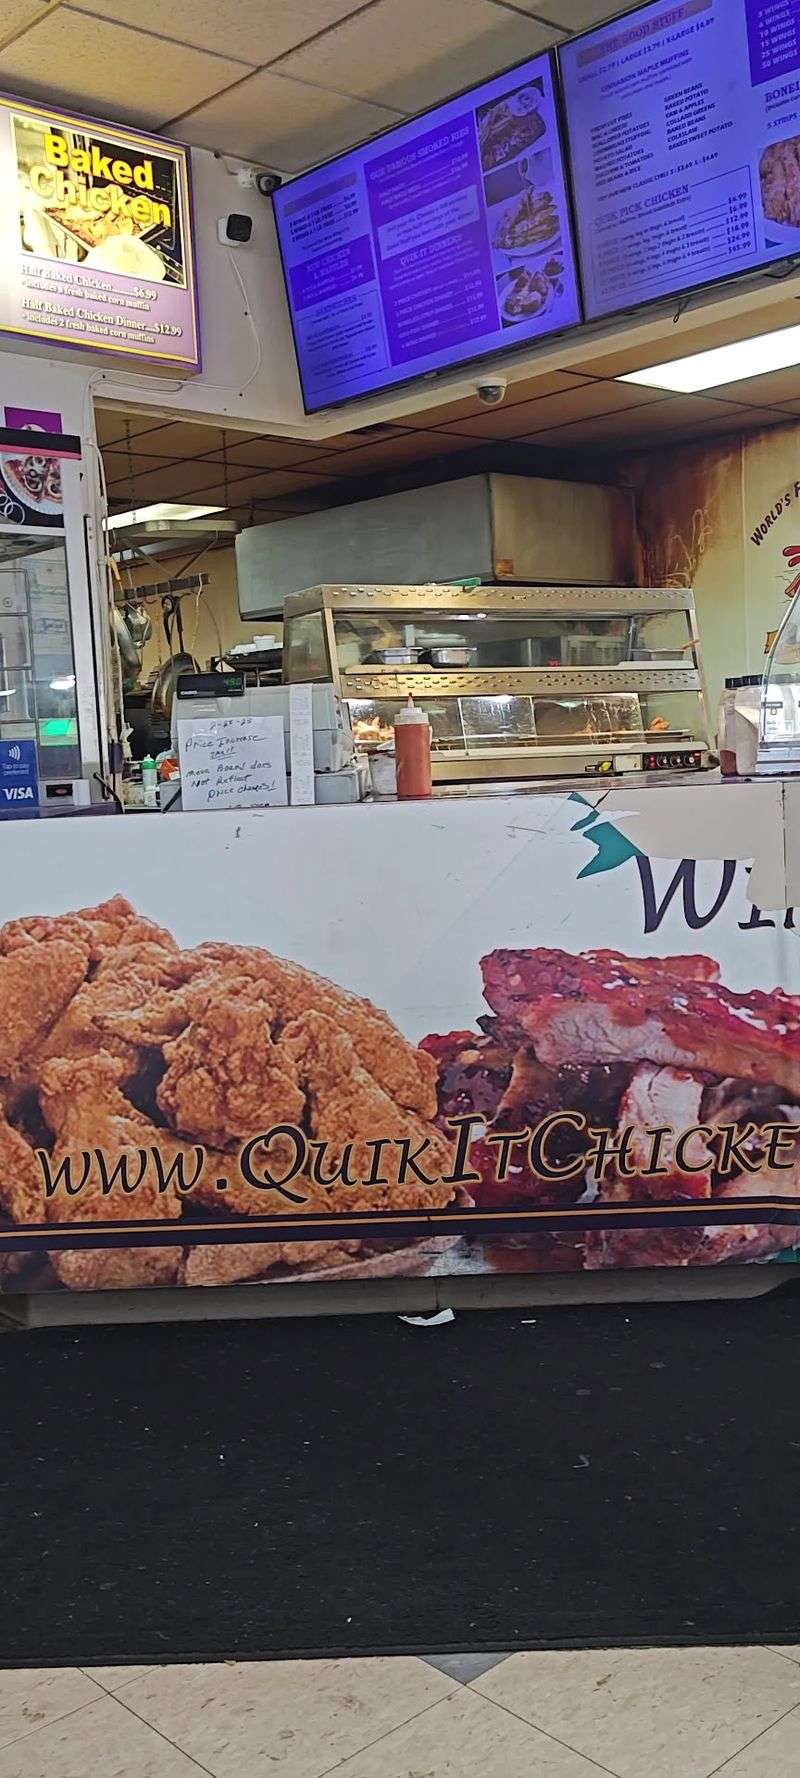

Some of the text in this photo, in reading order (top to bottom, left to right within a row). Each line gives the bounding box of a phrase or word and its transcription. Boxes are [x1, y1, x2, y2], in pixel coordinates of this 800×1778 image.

[770, 18, 795, 33] WINGS
[771, 28, 796, 43] WINGS
[772, 38, 797, 54] WINGS
[620, 50, 642, 67] LARGE
[772, 49, 798, 64] WINGS
[637, 61, 659, 76] MAPLE
[664, 89, 683, 103] GREEN
[683, 83, 703, 95] BEANS
[665, 88, 709, 111] BAKED POTATO
[665, 108, 678, 119] YAM
[684, 99, 705, 112] APPLES
[666, 102, 716, 127] COLLARD GREENS
[622, 121, 650, 137] POTATOES
[666, 115, 706, 135] BAKED BEANS
[667, 126, 698, 143] COLESLAW
[668, 121, 734, 151] BAKED SWEET POTATO
[44, 133, 154, 191] Baked
[616, 147, 645, 163] POTATOES
[624, 152, 654, 169] TOMATOES
[30, 165, 172, 228] Chicken
[620, 200, 642, 219] PICK
[644, 184, 689, 208] CHICKEN
[22, 264, 43, 276] Half
[76, 275, 112, 291] Chicken
[64, 284, 83, 298] fresh
[108, 295, 125, 306] corn
[22, 297, 183, 337] Half Baked Chicken Dinner $12.99
[66, 320, 84, 332] fresh
[86, 323, 108, 336] baked
[109, 329, 127, 339] corn
[127, 331, 155, 344] muffins
[750, 492, 791, 546] WORLD'S
[185, 738, 214, 753] Price
[250, 760, 272, 769] does
[2, 787, 34, 800] VISA
